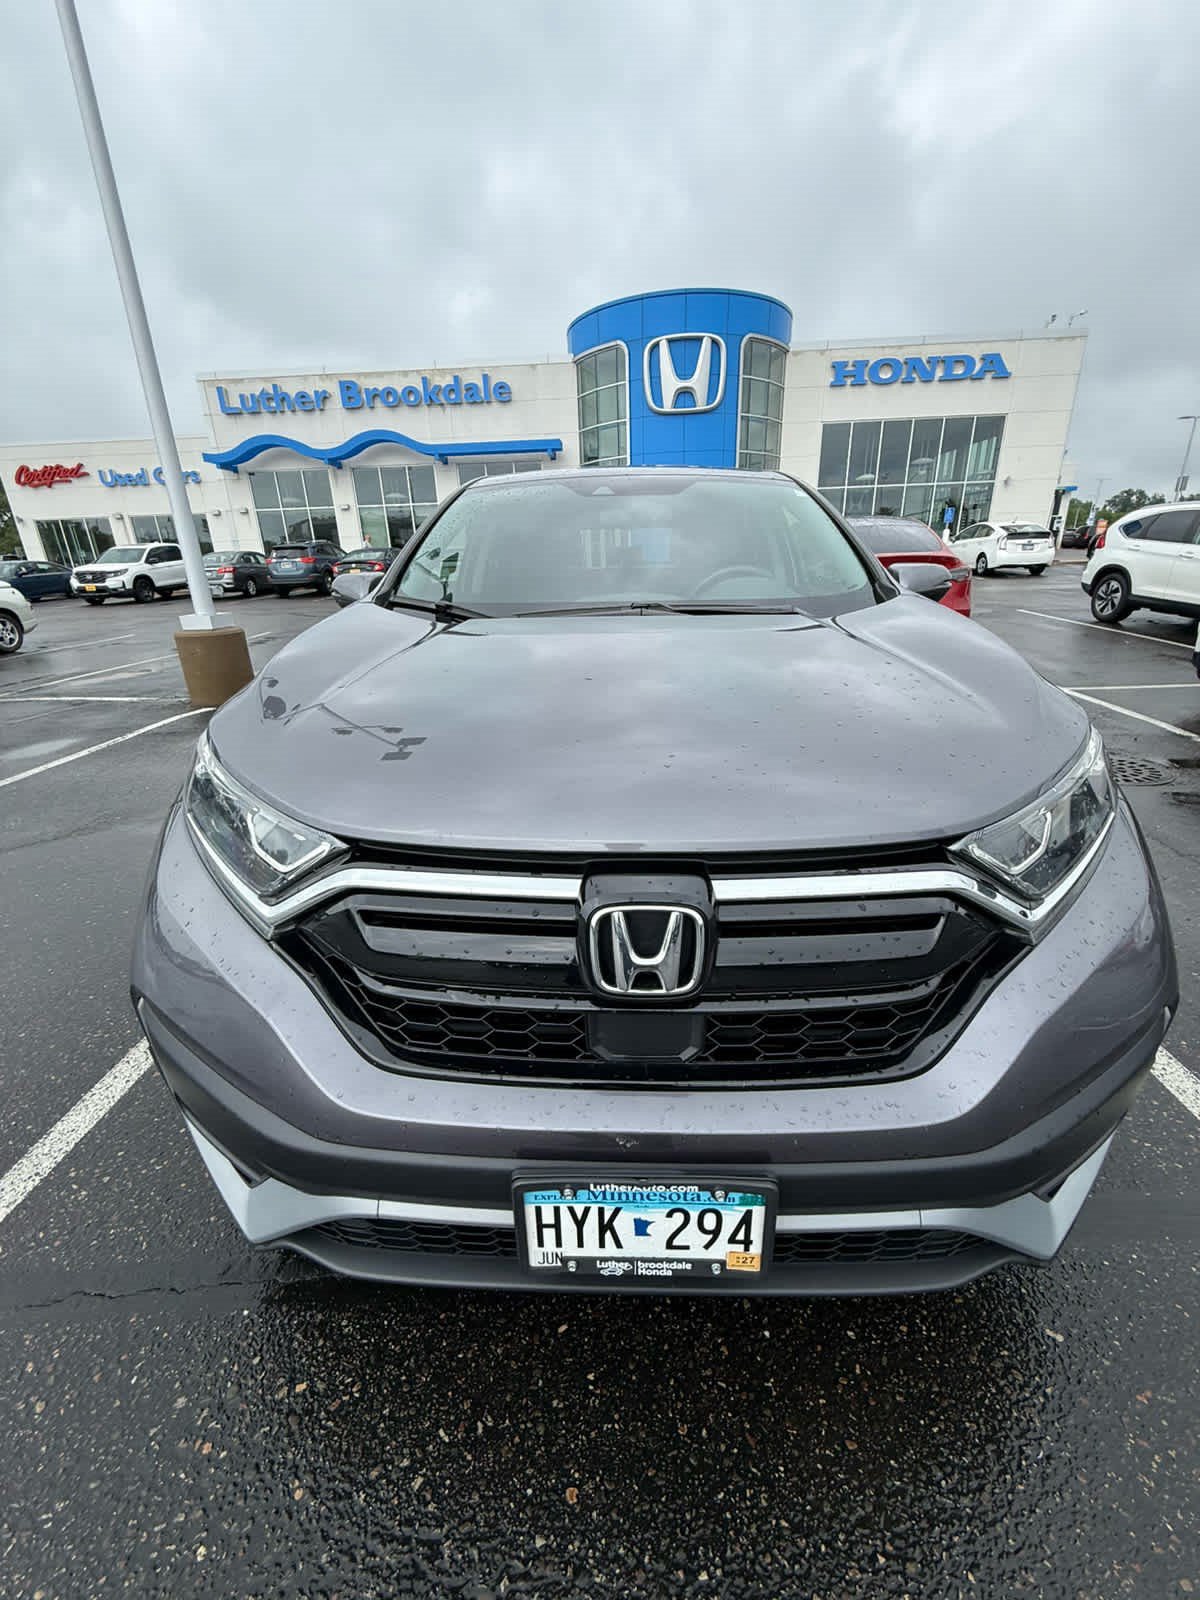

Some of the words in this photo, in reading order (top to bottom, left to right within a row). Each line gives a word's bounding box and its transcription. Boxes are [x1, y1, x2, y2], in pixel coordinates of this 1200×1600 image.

[830, 352, 1011, 387] HONDA
[216, 383, 332, 415] Luther
[338, 373, 513, 410] Brookdale
[14, 462, 90, 488] Certified
[98, 467, 150, 488] Used
[152, 466, 201, 486] Crs
[534, 1205, 624, 1249] HYK
[665, 1207, 754, 1252] 294
[537, 1251, 564, 1265] JUN
[637, 1260, 692, 1270] brookdale
[637, 1268, 673, 1276] Honda
